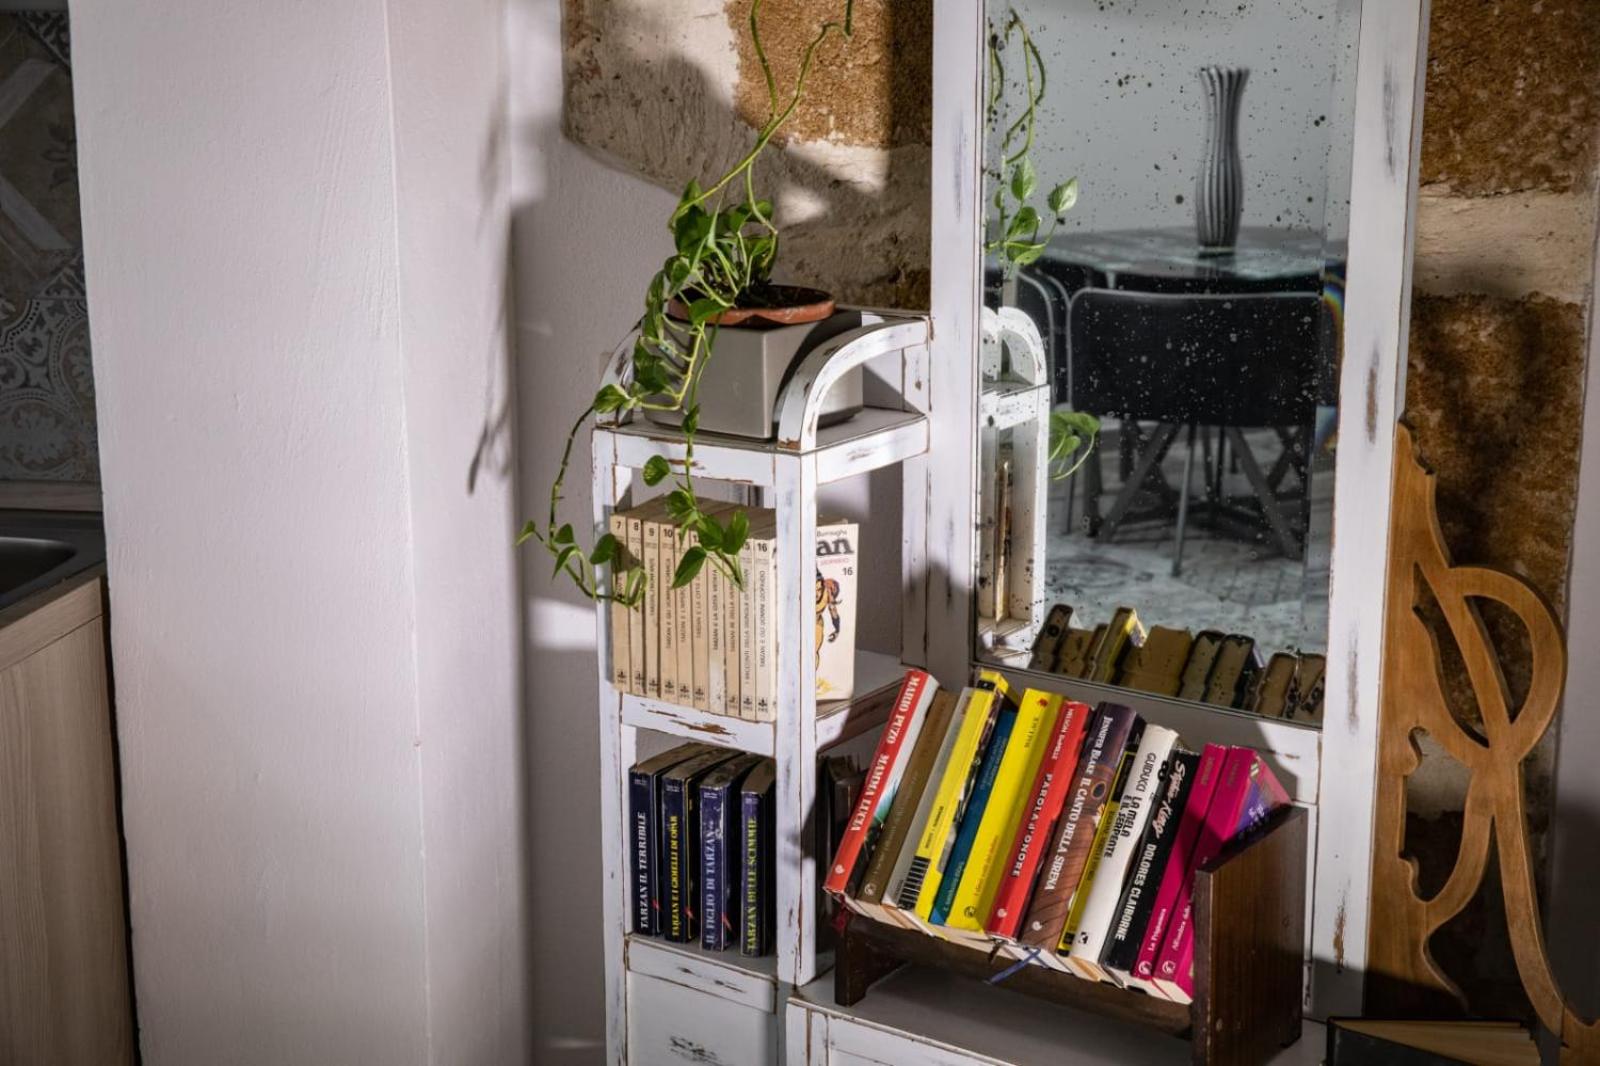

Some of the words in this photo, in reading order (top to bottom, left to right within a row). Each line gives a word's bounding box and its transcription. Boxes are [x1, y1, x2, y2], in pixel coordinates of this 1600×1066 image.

[634, 522, 639, 531] 8
[649, 528, 655, 537] 9
[663, 528, 673, 538] 10
[757, 543, 767, 552] 16
[843, 567, 853, 576] 16
[899, 675, 919, 710] MARIO
[887, 713, 903, 744] PUZO
[1062, 708, 1074, 733] NELSON
[1095, 715, 1113, 749] JENNIFER
[865, 753, 889, 797] MAMMA
[1085, 749, 1101, 775] BLAKE
[1136, 752, 1157, 792] GUIDUCCI
[1032, 773, 1052, 821] PAROLA
[1079, 776, 1091, 787] IL
[1168, 760, 1186, 803] Stephen
[850, 798, 871, 832] LUCIA
[1068, 787, 1087, 822] CANTO
[1120, 801, 1130, 810] IL
[1131, 796, 1142, 809] LA
[1152, 800, 1173, 839] King
[638, 811, 647, 869] TERRIBILE
[668, 815, 677, 838] OPAR
[747, 817, 756, 865] SCIMMIE
[1056, 821, 1075, 855] DELLA
[669, 839, 678, 849] DI
[705, 831, 715, 874] TARZAN
[639, 872, 647, 883] IL
[669, 851, 679, 888] GIOIELLI
[1044, 855, 1064, 891] SIRENA
[1134, 843, 1156, 886] DOLORES
[706, 878, 715, 890] DI
[747, 869, 757, 902] DELLE
[640, 884, 648, 928] TARZAN
[671, 902, 680, 935] TARZAN
[706, 893, 715, 928] FIGLIO
[1115, 886, 1141, 941] CLAIBORNE
[706, 934, 715, 943] IL
[746, 906, 757, 949] TARZAN
